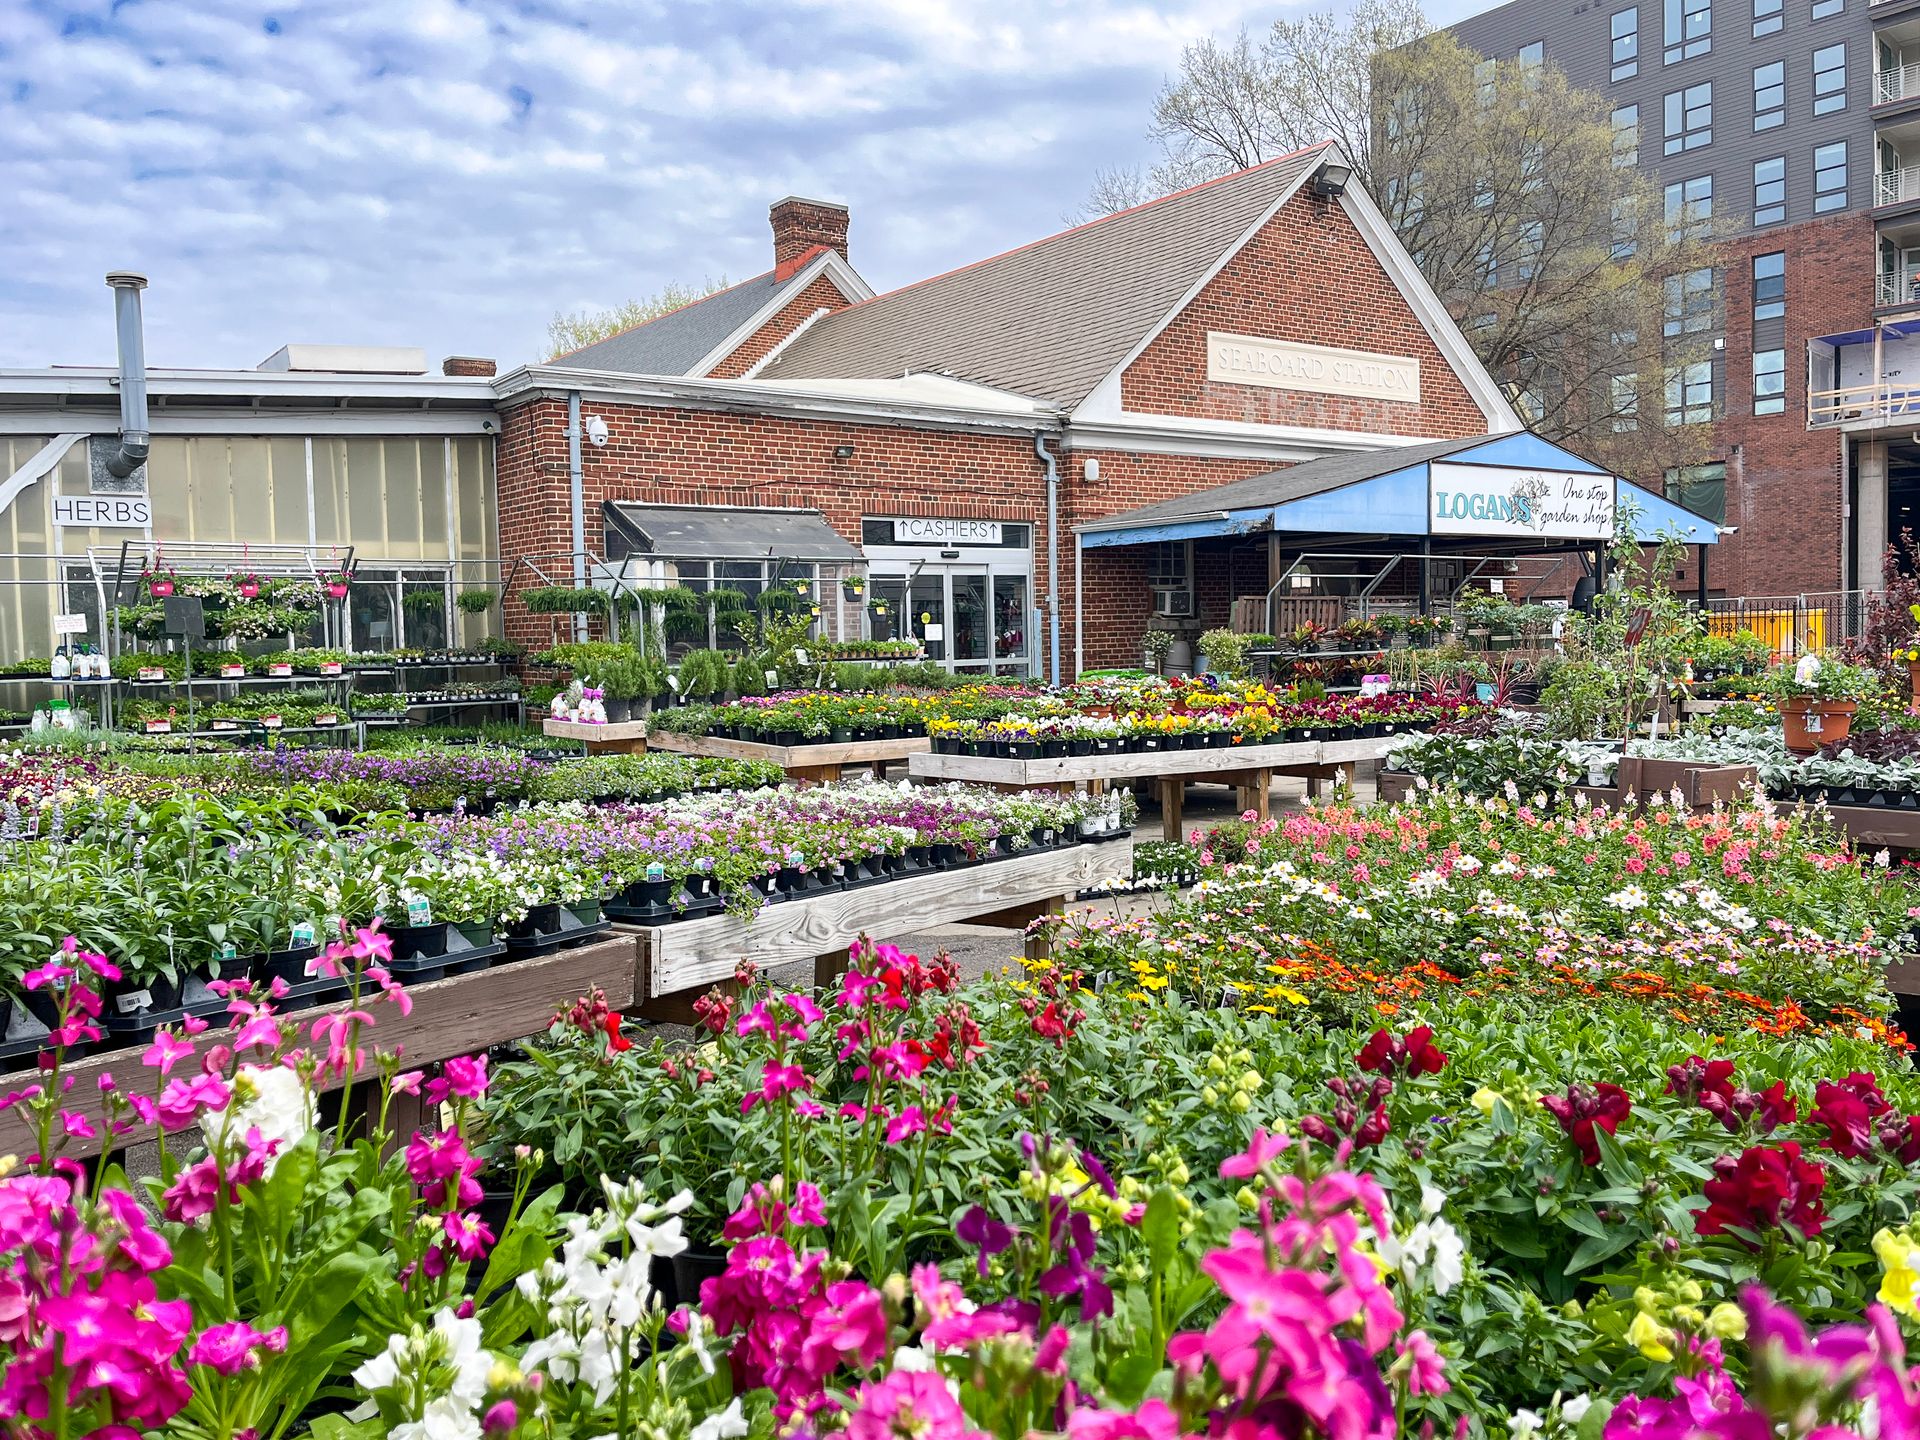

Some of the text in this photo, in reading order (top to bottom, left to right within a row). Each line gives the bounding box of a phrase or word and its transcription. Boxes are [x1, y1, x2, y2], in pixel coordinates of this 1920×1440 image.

[1218, 348, 1409, 390] SEABOARD STATION
[1436, 491, 1531, 522] LOGAN'S
[1562, 477, 1608, 509] One stop
[55, 500, 148, 522] HERBS
[1540, 503, 1608, 533] garden shop
[910, 520, 988, 537] CASHIERS
